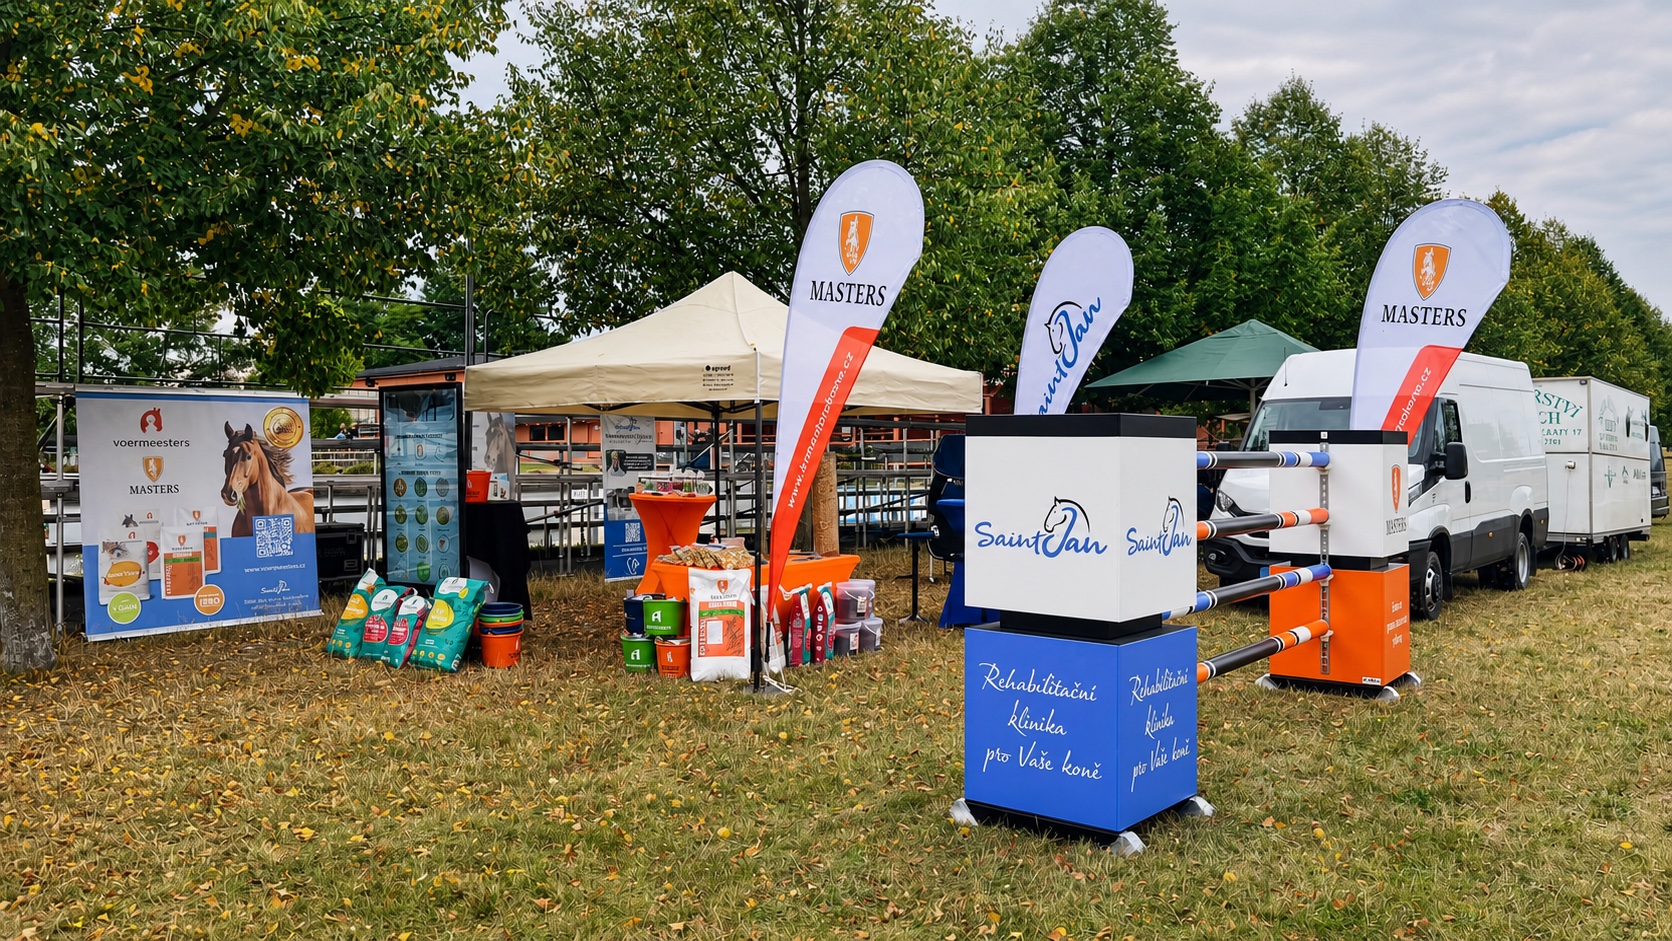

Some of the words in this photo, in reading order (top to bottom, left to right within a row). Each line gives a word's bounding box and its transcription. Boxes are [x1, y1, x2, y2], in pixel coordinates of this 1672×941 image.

[810, 280, 887, 306] MASTERS
[1381, 304, 1467, 327] MASTERS
[1039, 297, 1101, 415] aintJan
[1534, 389, 1583, 418] RSTVÍ
[1538, 411, 1561, 425] CH
[113, 438, 190, 447] voermeesters
[130, 484, 180, 495] MASTERS
[979, 662, 1098, 702] Rehabilitační
[1128, 668, 1189, 706] Rehabilitační
[1007, 699, 1067, 737] klinika
[1144, 702, 1176, 740] klinika
[982, 747, 1012, 773] pro
[1019, 741, 1054, 770] Vaše
[1061, 749, 1103, 780] koně
[1130, 761, 1147, 793] pro
[1150, 739, 1168, 772] Vaše
